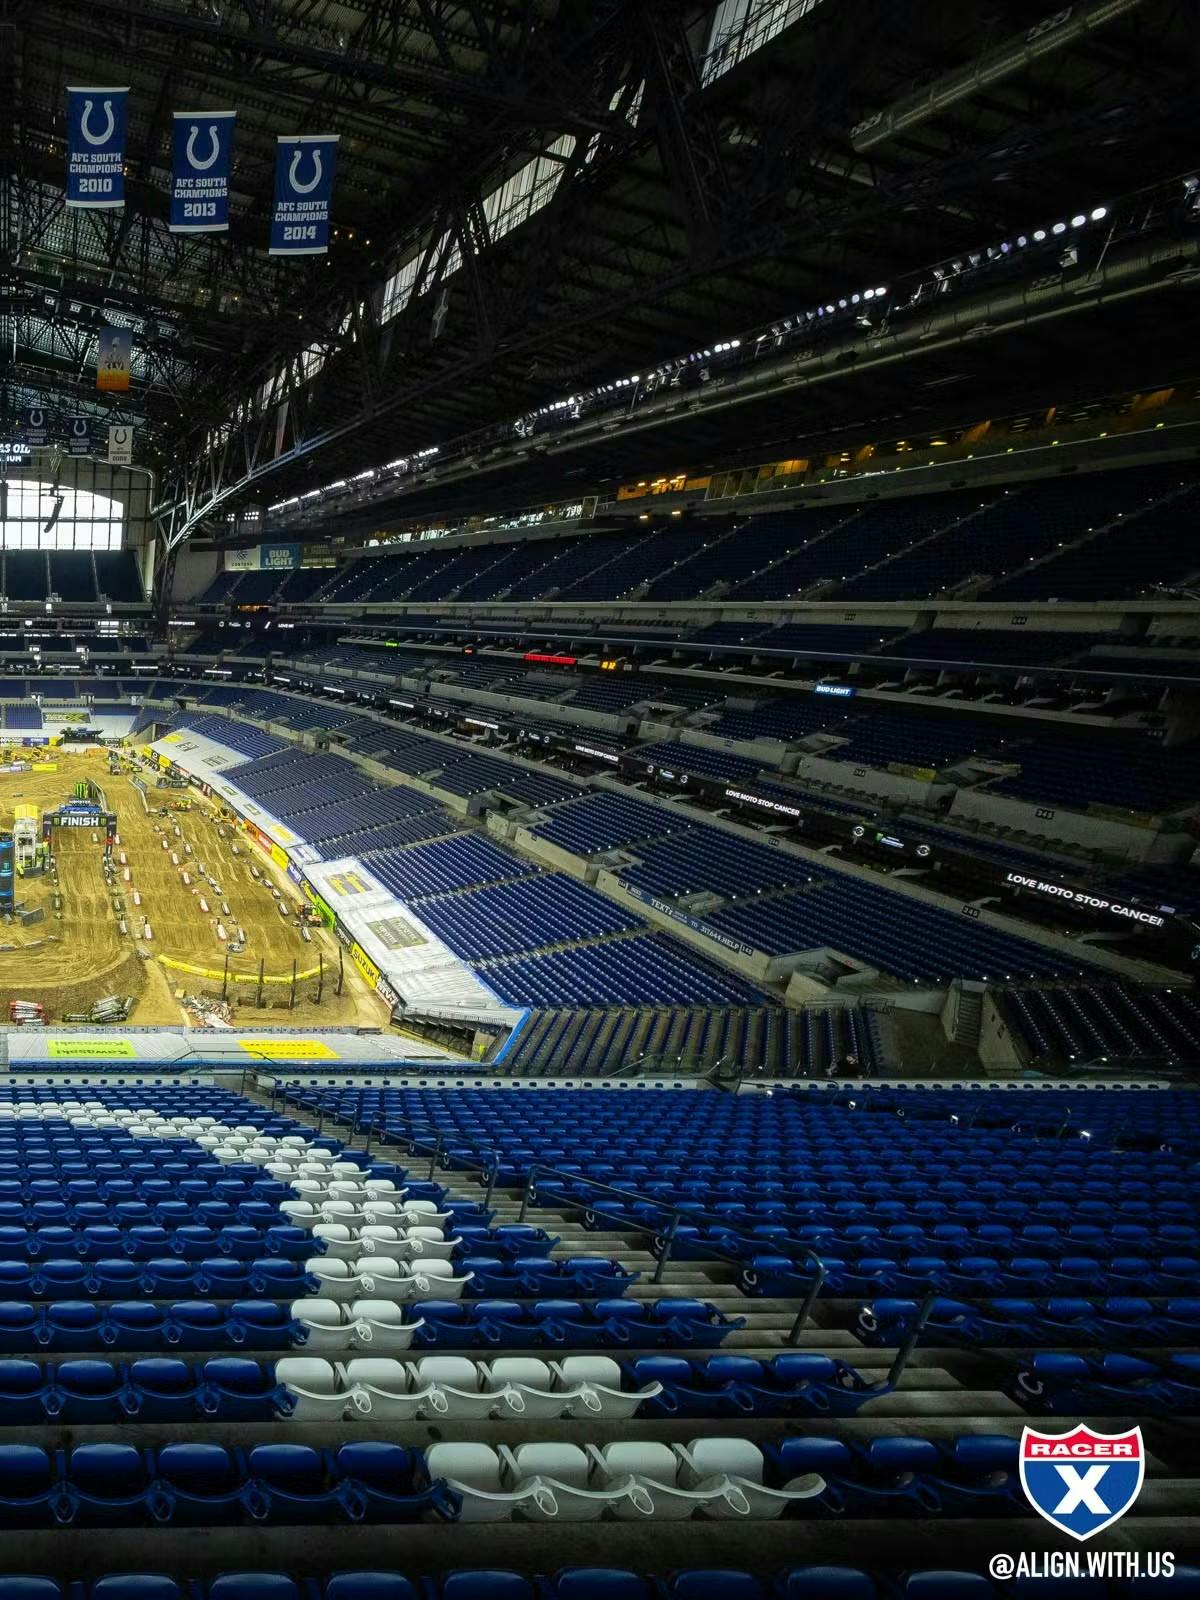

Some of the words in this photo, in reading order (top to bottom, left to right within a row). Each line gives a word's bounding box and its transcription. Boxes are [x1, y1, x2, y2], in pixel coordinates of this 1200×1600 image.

[71, 153, 89, 163] AFC
[91, 152, 121, 162] SOUTH
[69, 163, 123, 173] CHAMPIONS
[79, 178, 112, 192] 2010
[176, 178, 193, 188] AFC
[195, 177, 227, 188] SOUTH
[174, 187, 228, 198] CHAMPIONS
[184, 203, 216, 217] 2013
[277, 202, 295, 212] AFC
[296, 200, 328, 211] SOUTH
[274, 211, 329, 222] CHAMPIONS
[283, 225, 317, 240] 2014
[13, 443, 31, 454] OIL
[269, 550, 289, 558] BUD
[265, 558, 294, 566] LIGHT
[816, 685, 830, 693] BUD
[830, 687, 849, 695] LIGHT
[725, 789, 740, 799] LOVE
[740, 793, 758, 803] MOTO
[757, 799, 774, 808] STOP
[774, 804, 800, 816] CANCER
[60, 816, 99, 826] FINISH
[1006, 873, 1036, 889] LOVE
[1037, 882, 1073, 900] MOTO
[1073, 893, 1110, 909] STOP
